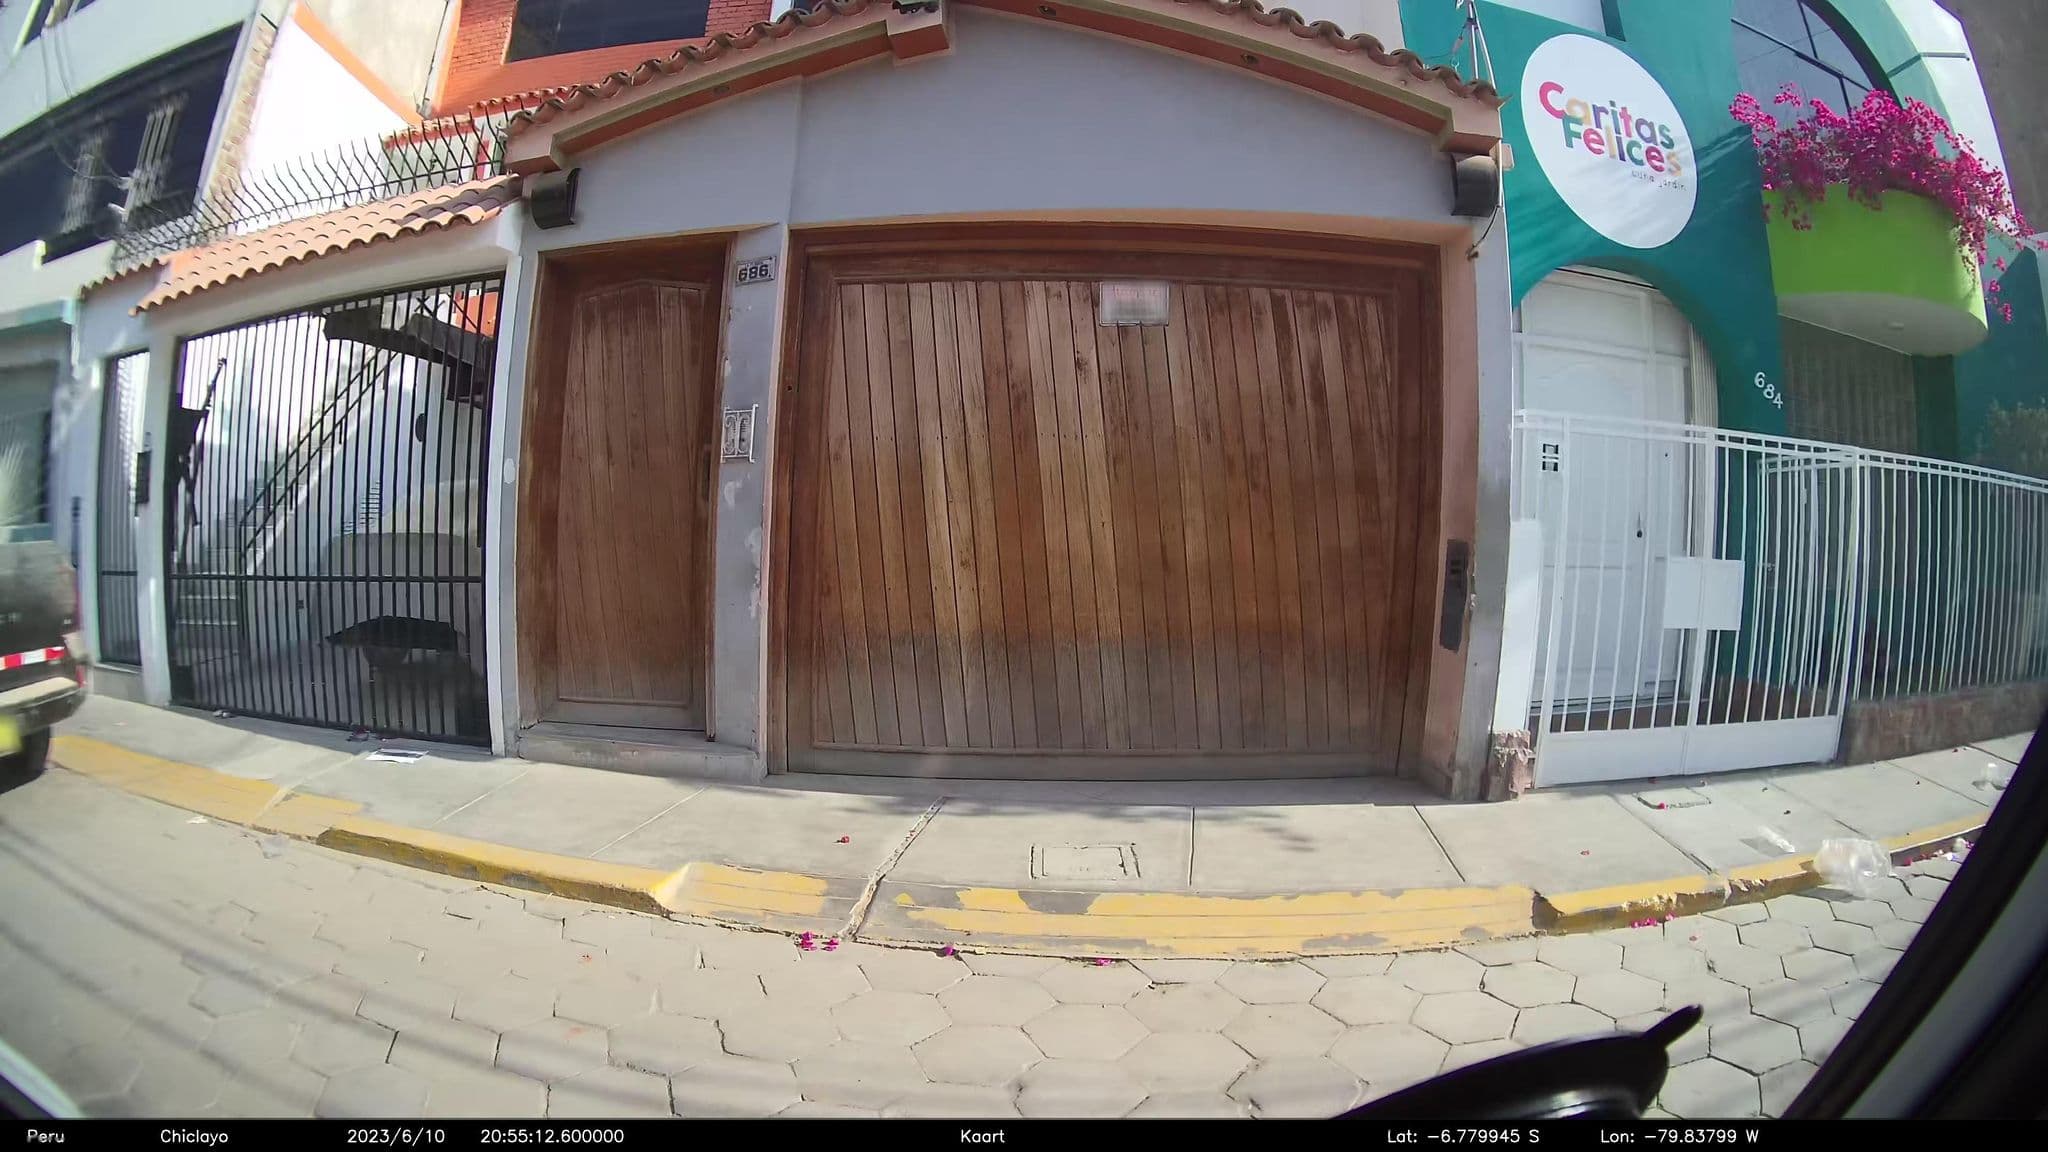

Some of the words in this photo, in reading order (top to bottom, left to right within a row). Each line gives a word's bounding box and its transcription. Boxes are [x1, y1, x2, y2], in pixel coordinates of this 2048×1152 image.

[1538, 81, 1675, 149] Caritas
[1562, 114, 1682, 176] Felices
[738, 264, 769, 281] 686
[1754, 371, 1784, 409] 684
